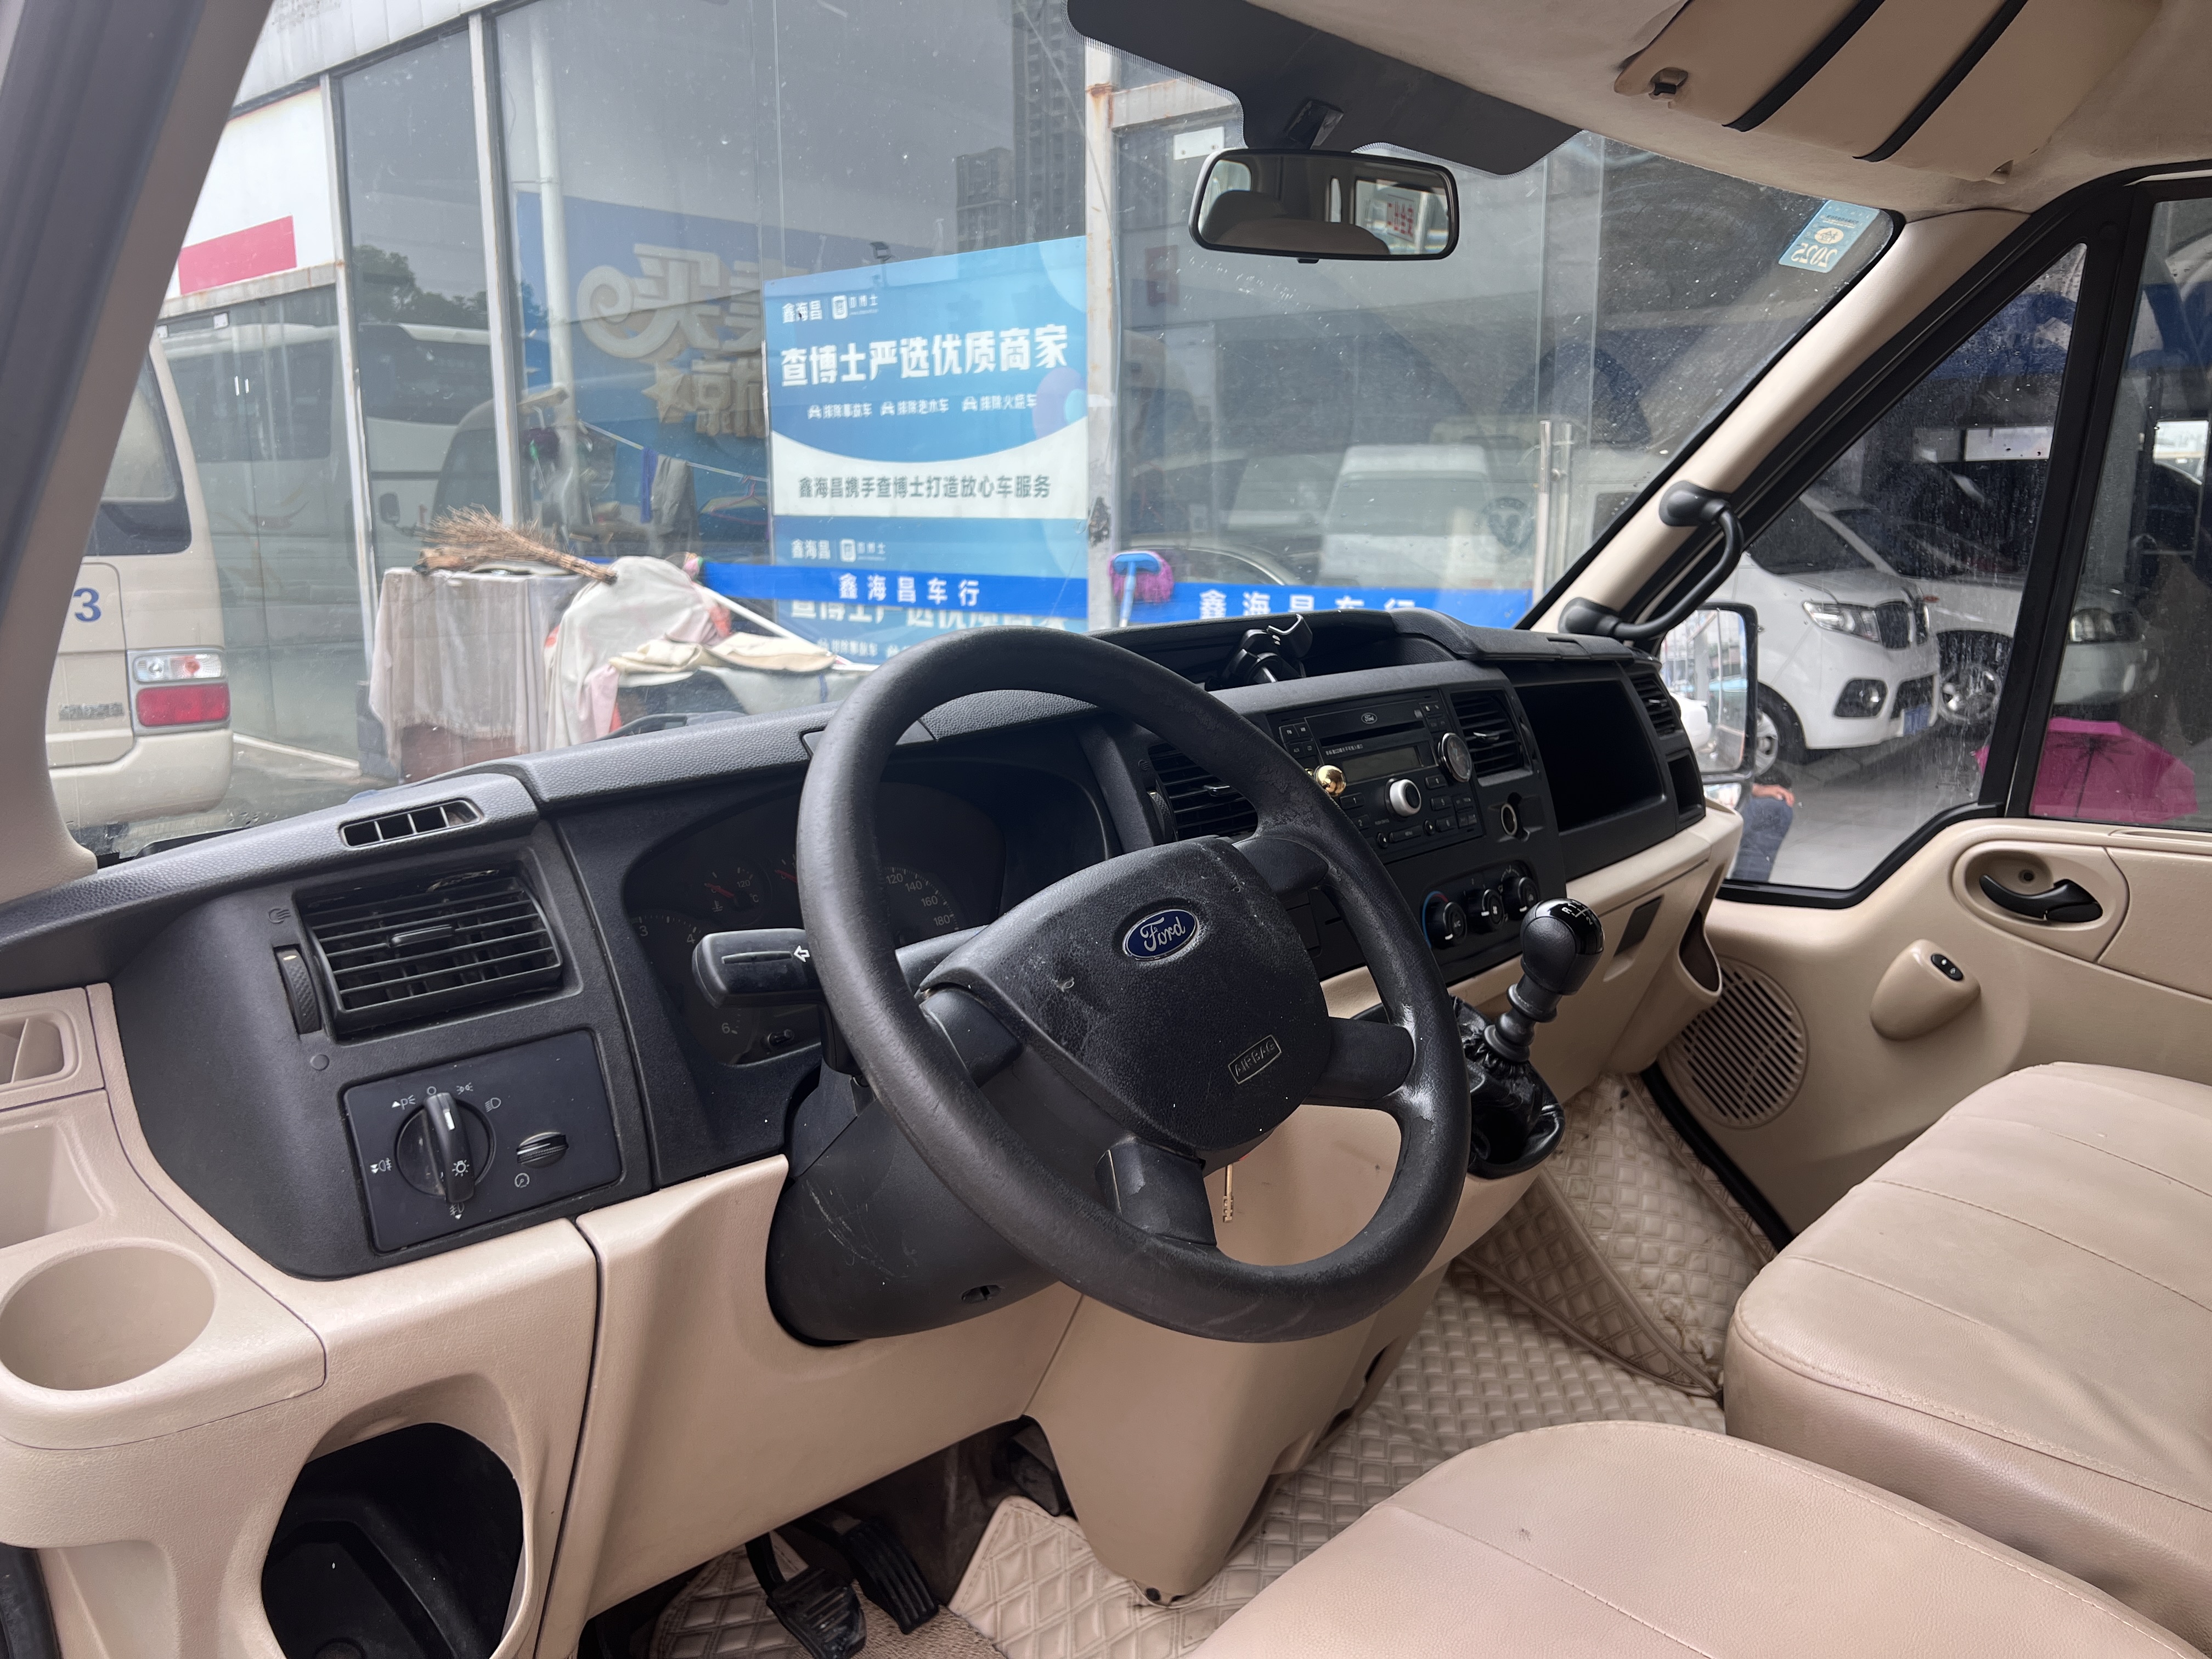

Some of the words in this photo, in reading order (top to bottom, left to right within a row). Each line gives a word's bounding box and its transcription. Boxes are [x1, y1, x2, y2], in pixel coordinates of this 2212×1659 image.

[782, 300, 822, 323] 鑫海昌
[781, 325, 1068, 387] 查博士严选优质商家
[798, 475, 1051, 498] 鑫海昌携手查博士打造放心车服务
[791, 539, 831, 560] 鑫海昌
[838, 573, 980, 607] 鑫海昌车行
[73, 587, 101, 622] 3
[737, 879, 751, 888] 120
[886, 873, 903, 884] 120
[905, 881, 922, 892] 140
[921, 895, 938, 907] 160
[934, 915, 950, 926] 180
[1586, 916, 1593, 925] 2
[639, 925, 648, 936] 3
[1140, 916, 1186, 951] Ford
[686, 934, 696, 944] 4
[721, 1022, 731, 1034] 6
[1235, 1040, 1275, 1077] AIRBAG
